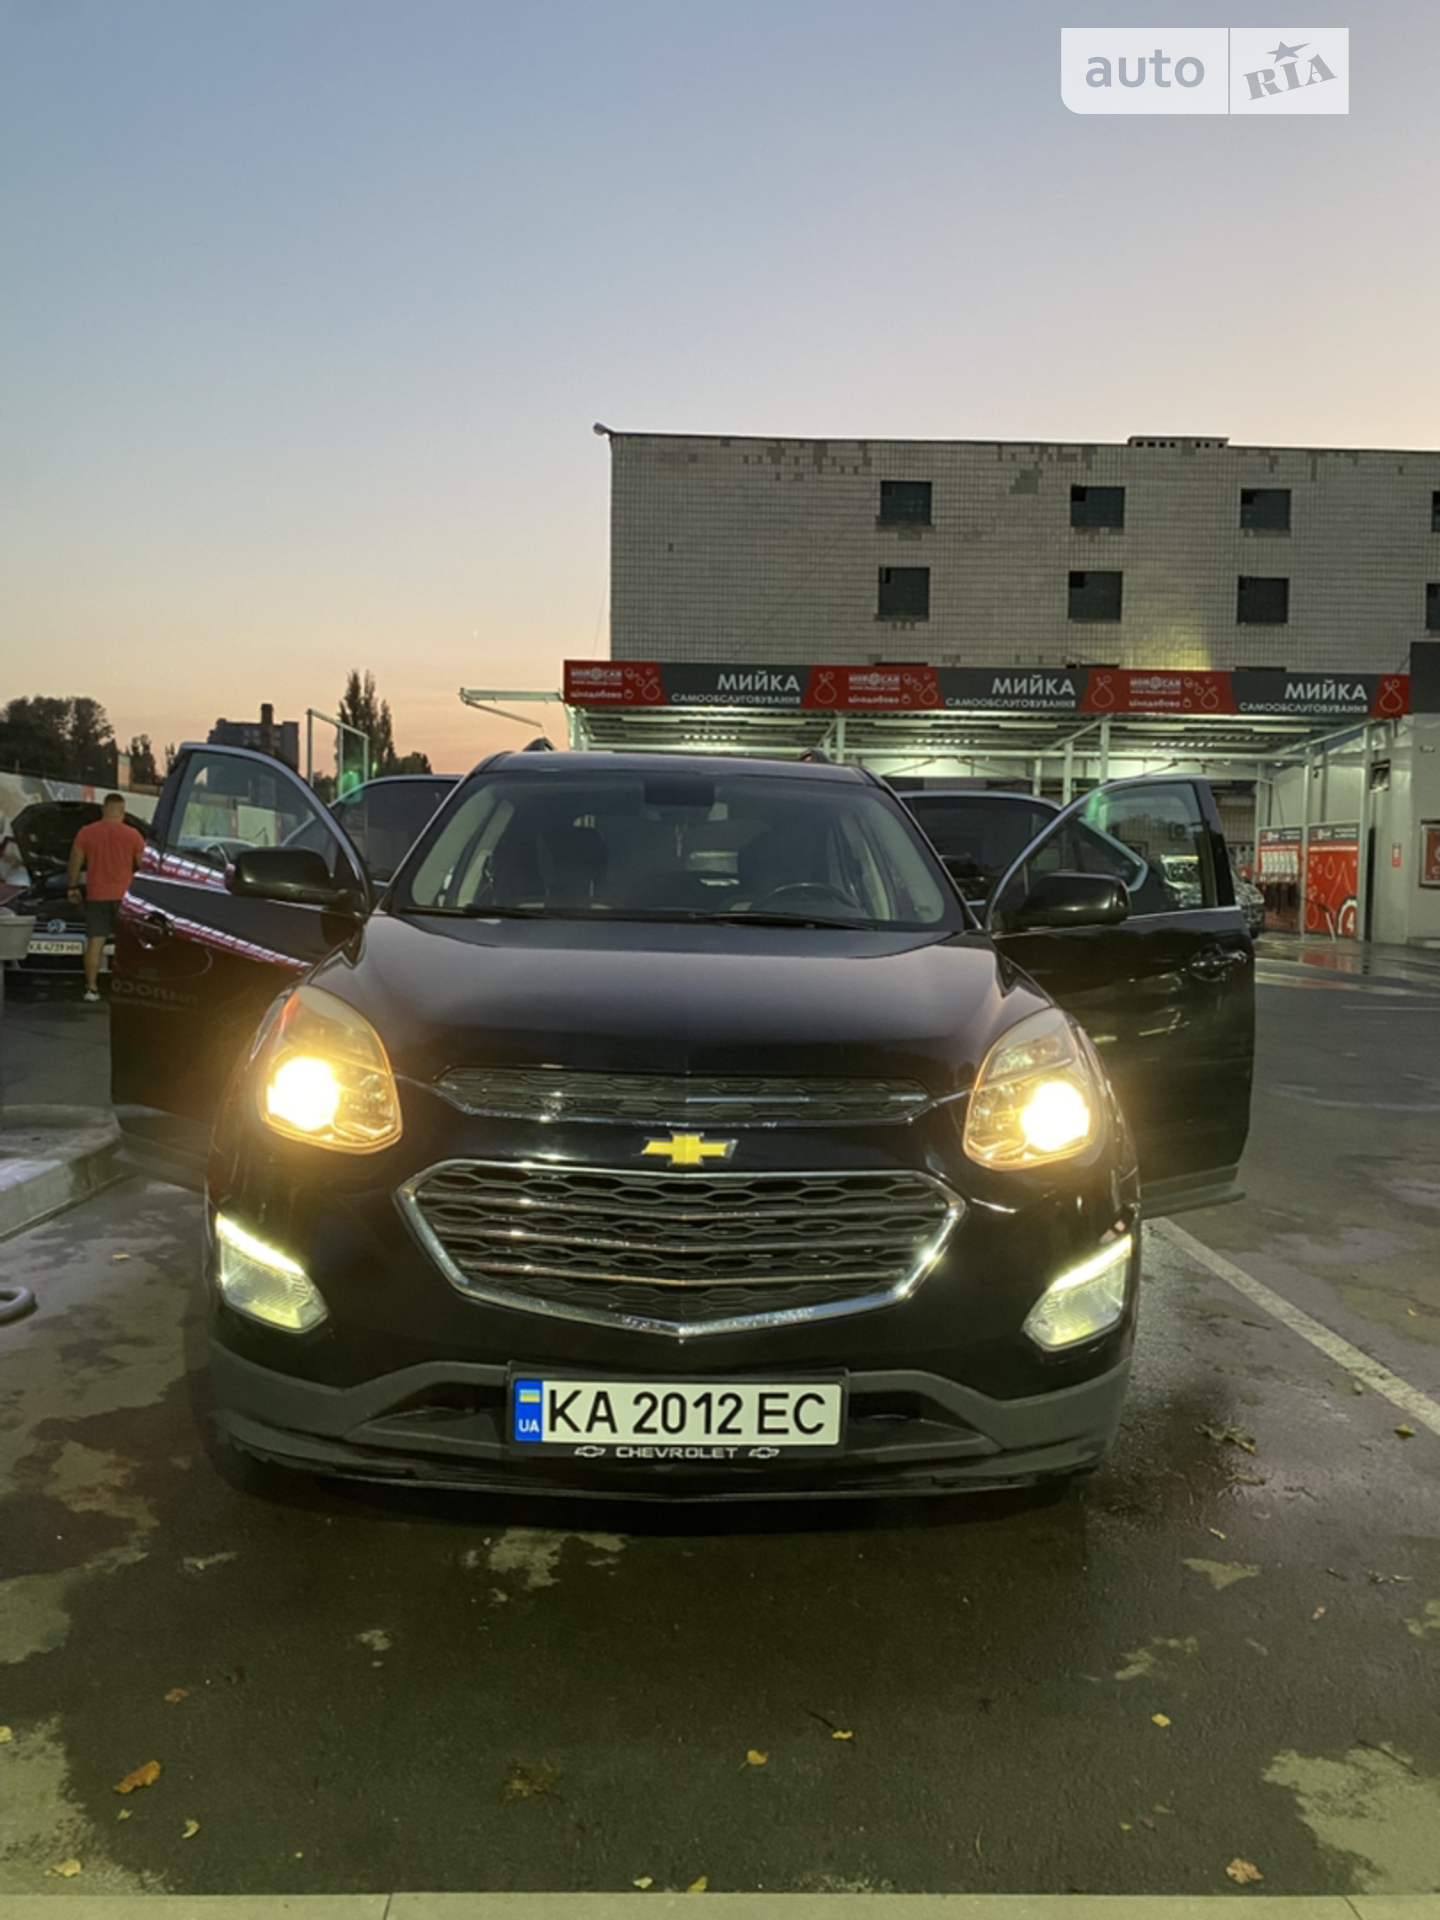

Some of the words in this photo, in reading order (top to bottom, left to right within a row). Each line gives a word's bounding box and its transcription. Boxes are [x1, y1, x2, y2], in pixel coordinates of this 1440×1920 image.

[717, 670, 801, 691] МИЙКА
[991, 674, 1076, 695] МИЙКА
[1284, 679, 1368, 700] МИЙКА
[549, 1389, 618, 1433] KA
[632, 1391, 743, 1434] 2012
[757, 1392, 826, 1435] EC
[518, 1419, 540, 1433] UA
[615, 1447, 738, 1459] CHEVROLET
